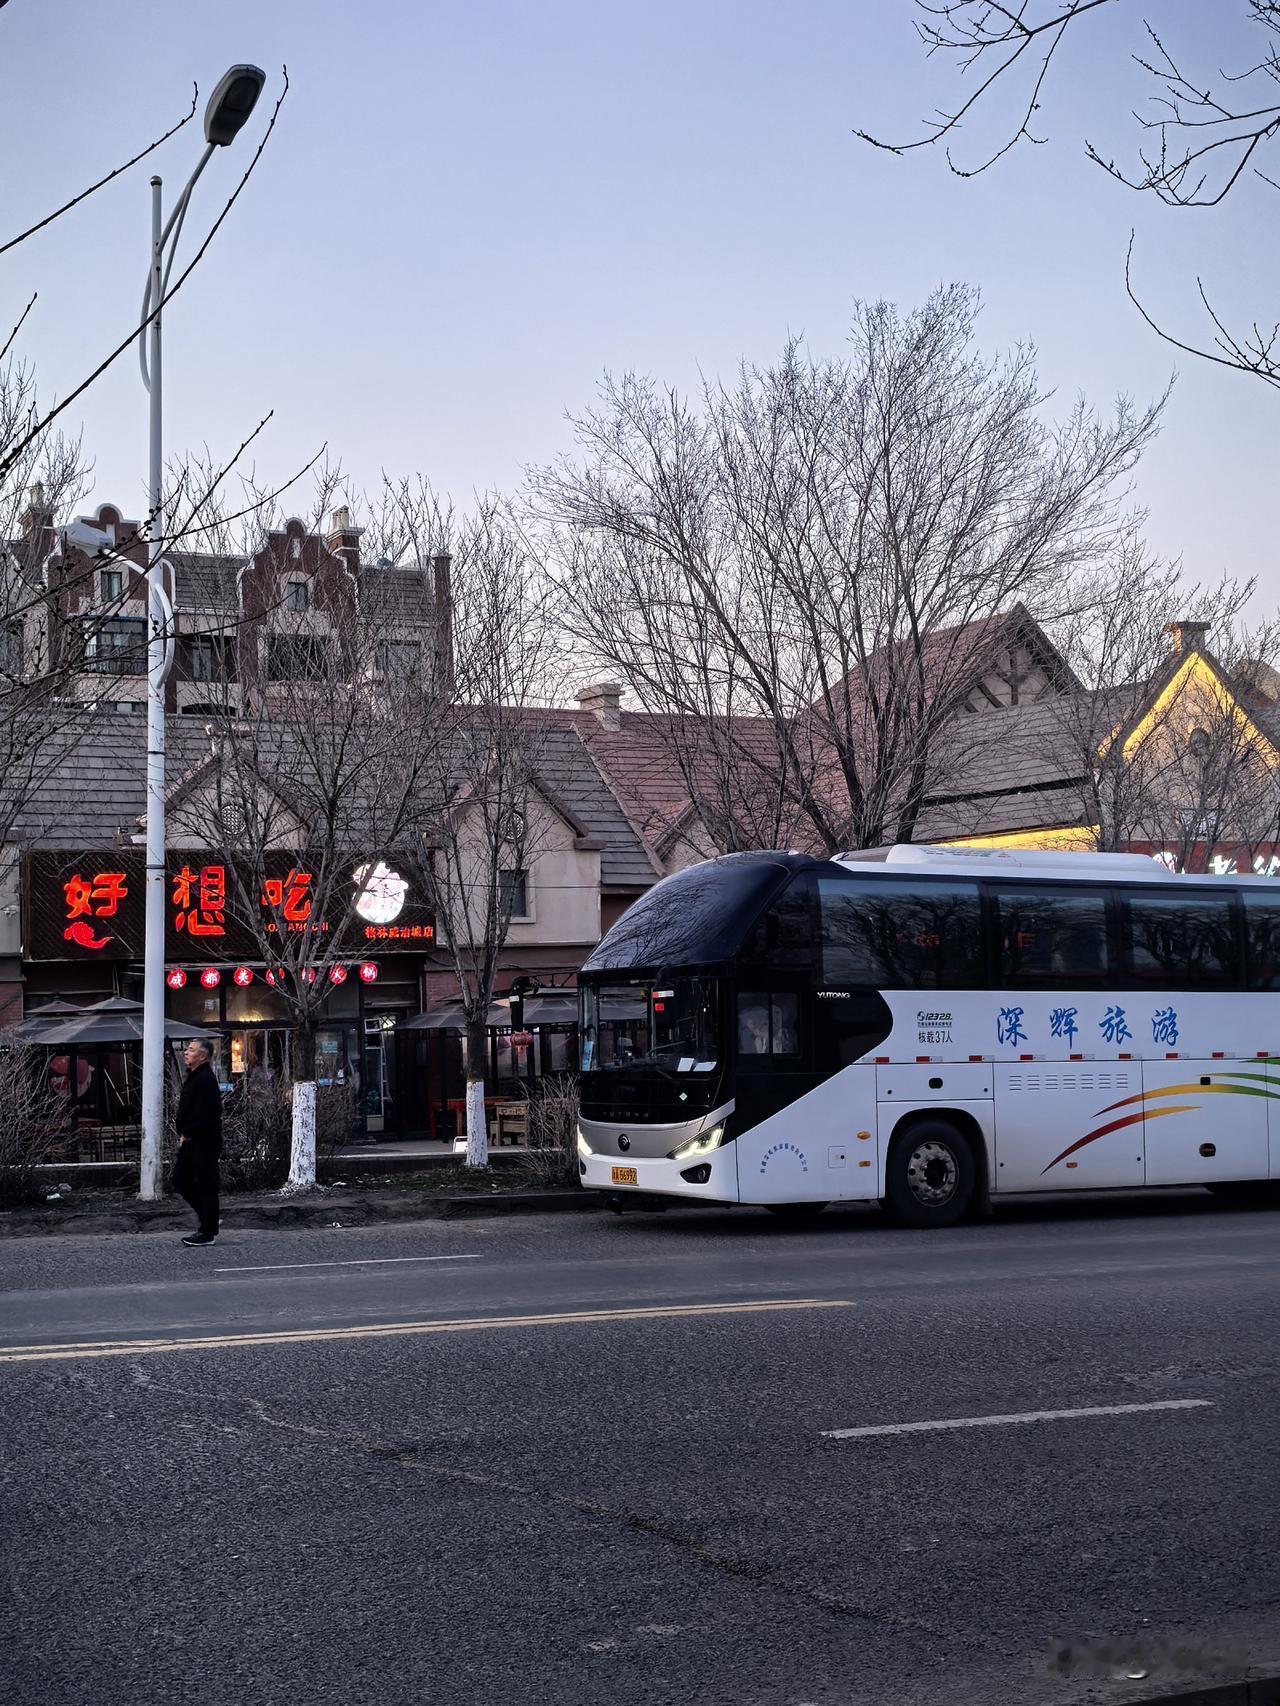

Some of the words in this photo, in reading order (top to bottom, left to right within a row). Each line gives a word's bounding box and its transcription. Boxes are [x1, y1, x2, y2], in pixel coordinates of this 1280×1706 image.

[63, 864, 313, 936] 好想吃
[816, 991, 850, 999] YUTONG
[918, 1030, 953, 1044] 核载37人
[996, 1005, 1179, 1049] 深辉旅游
